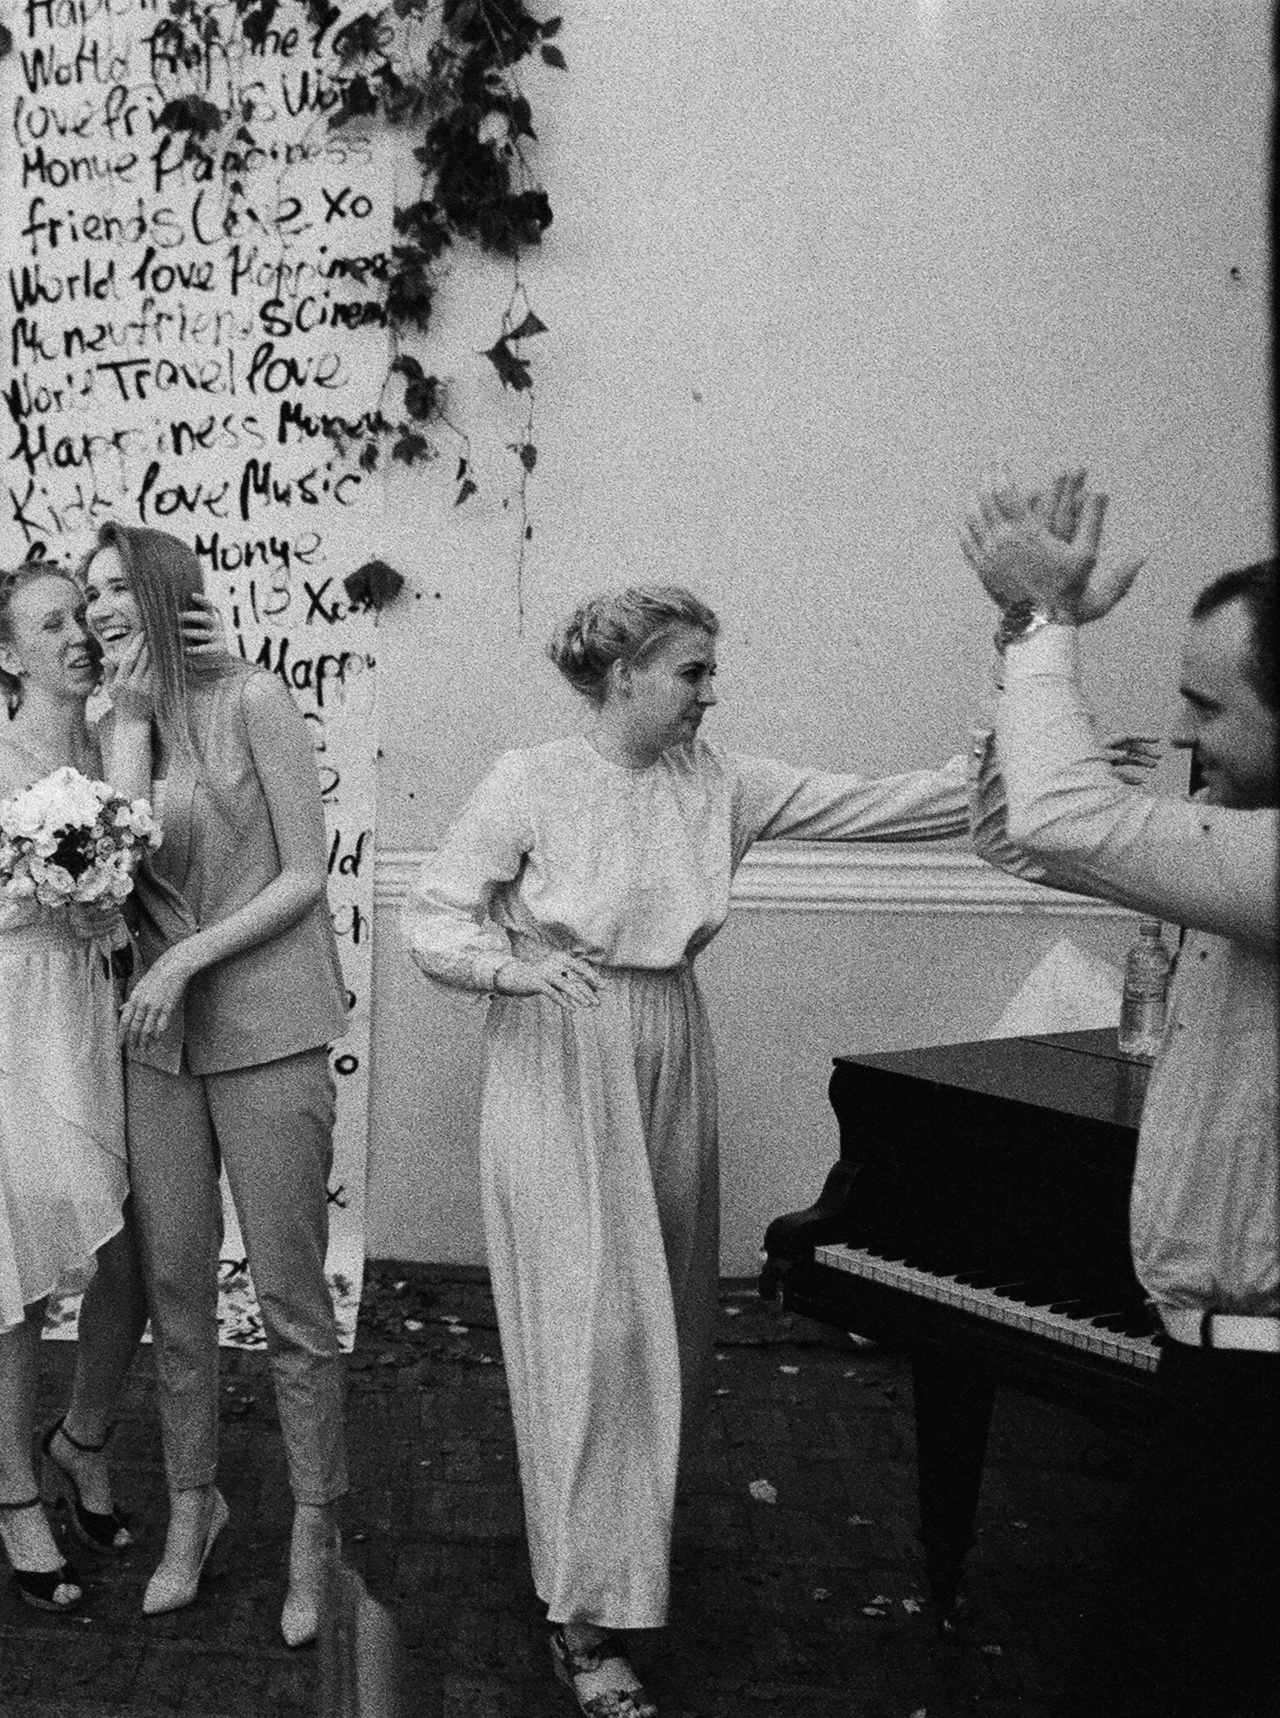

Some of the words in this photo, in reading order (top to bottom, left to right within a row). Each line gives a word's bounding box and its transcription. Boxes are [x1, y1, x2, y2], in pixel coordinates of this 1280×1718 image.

[21, 196, 186, 257] friends
[9, 257, 120, 313] World
[131, 246, 216, 293] love
[96, 346, 236, 402] Travel
[245, 341, 352, 395] love
[137, 460, 230, 524] love
[239, 458, 362, 521] Music
